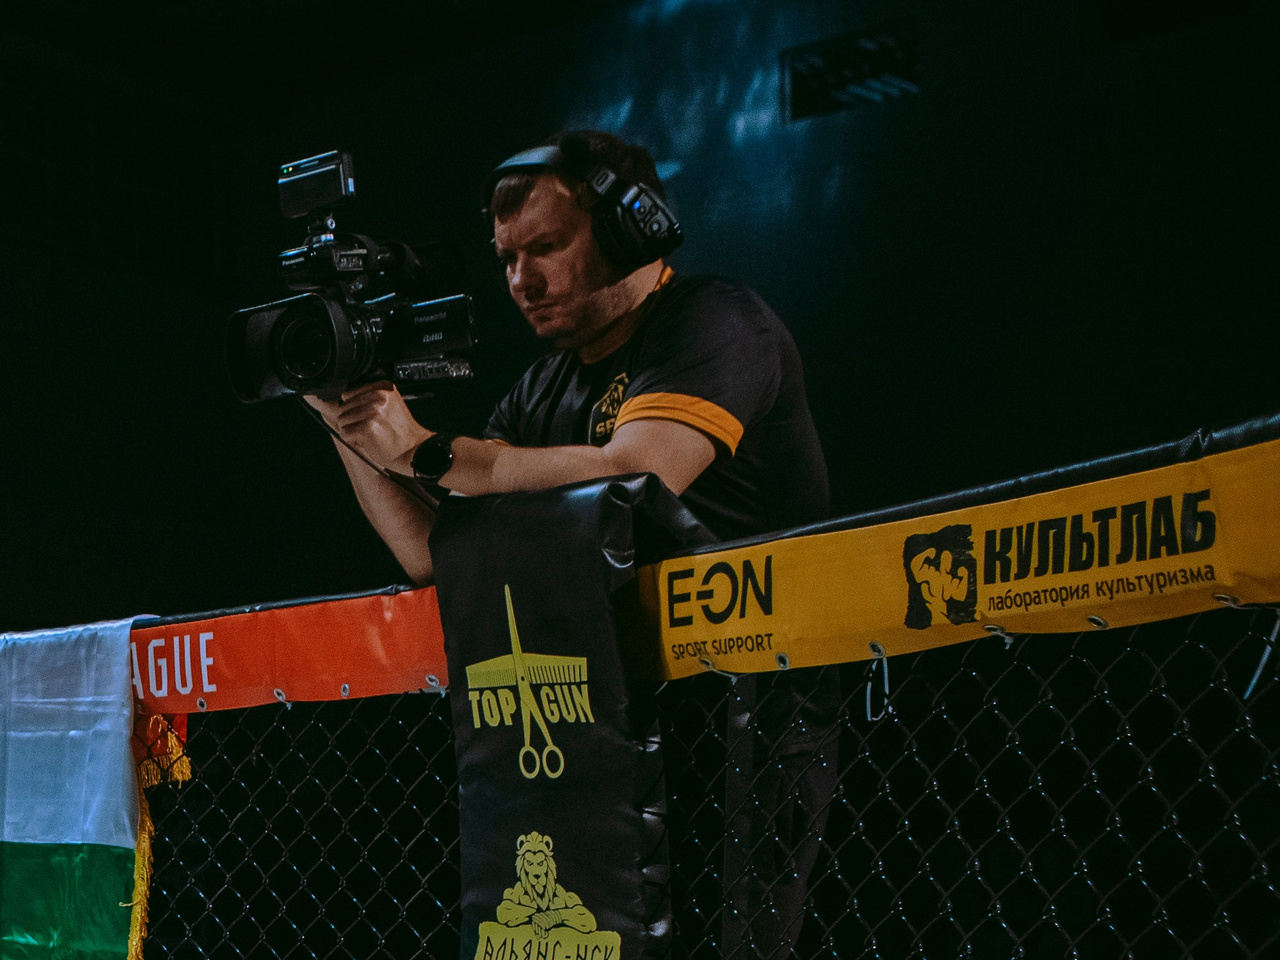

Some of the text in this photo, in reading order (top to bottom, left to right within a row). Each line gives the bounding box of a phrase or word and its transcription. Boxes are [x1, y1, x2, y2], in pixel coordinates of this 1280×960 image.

[983, 489, 1216, 585] КУЛЬТЛАБ
[987, 564, 1216, 612] лаборатория культуризма
[671, 633, 773, 660] SPORT SUPPORT
[468, 683, 595, 729] TOP GUN
